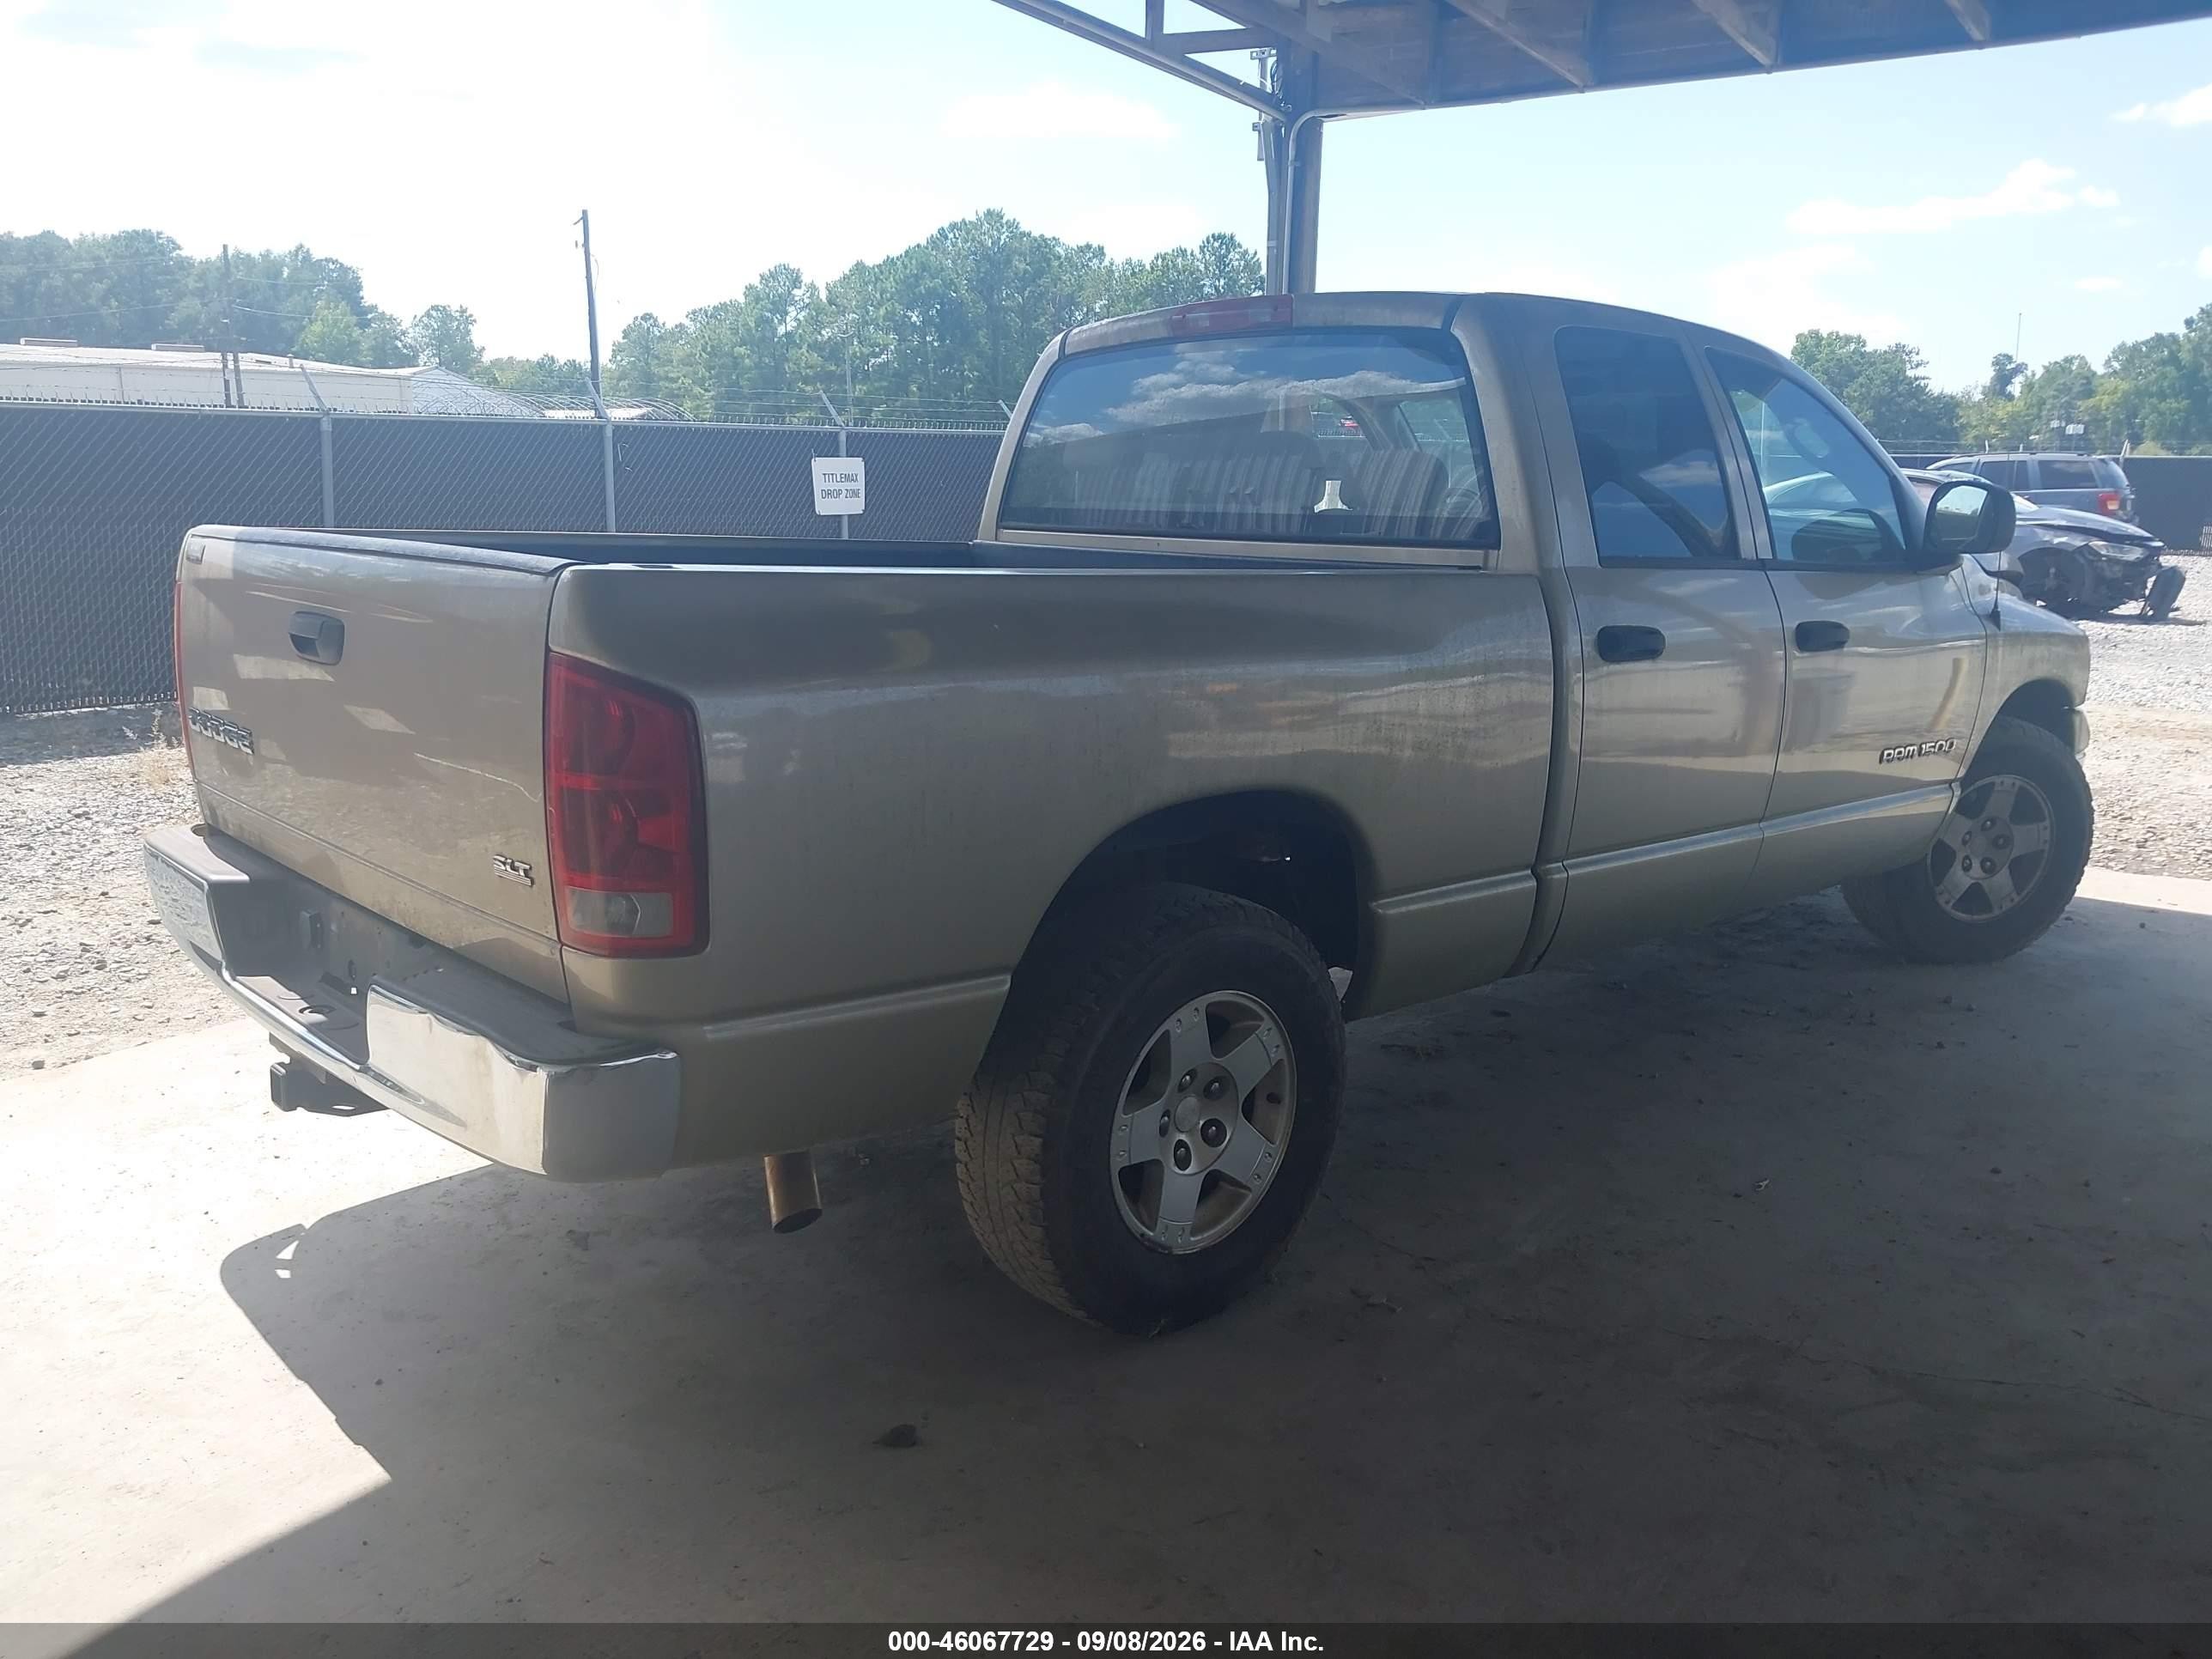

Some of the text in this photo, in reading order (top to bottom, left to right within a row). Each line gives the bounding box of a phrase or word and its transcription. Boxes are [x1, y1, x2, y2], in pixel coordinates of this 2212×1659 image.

[822, 472, 859, 483] TITLEMAX
[821, 489, 861, 499] DROP ZONE
[1918, 738, 1956, 757] 1500
[493, 854, 532, 878] SLT
